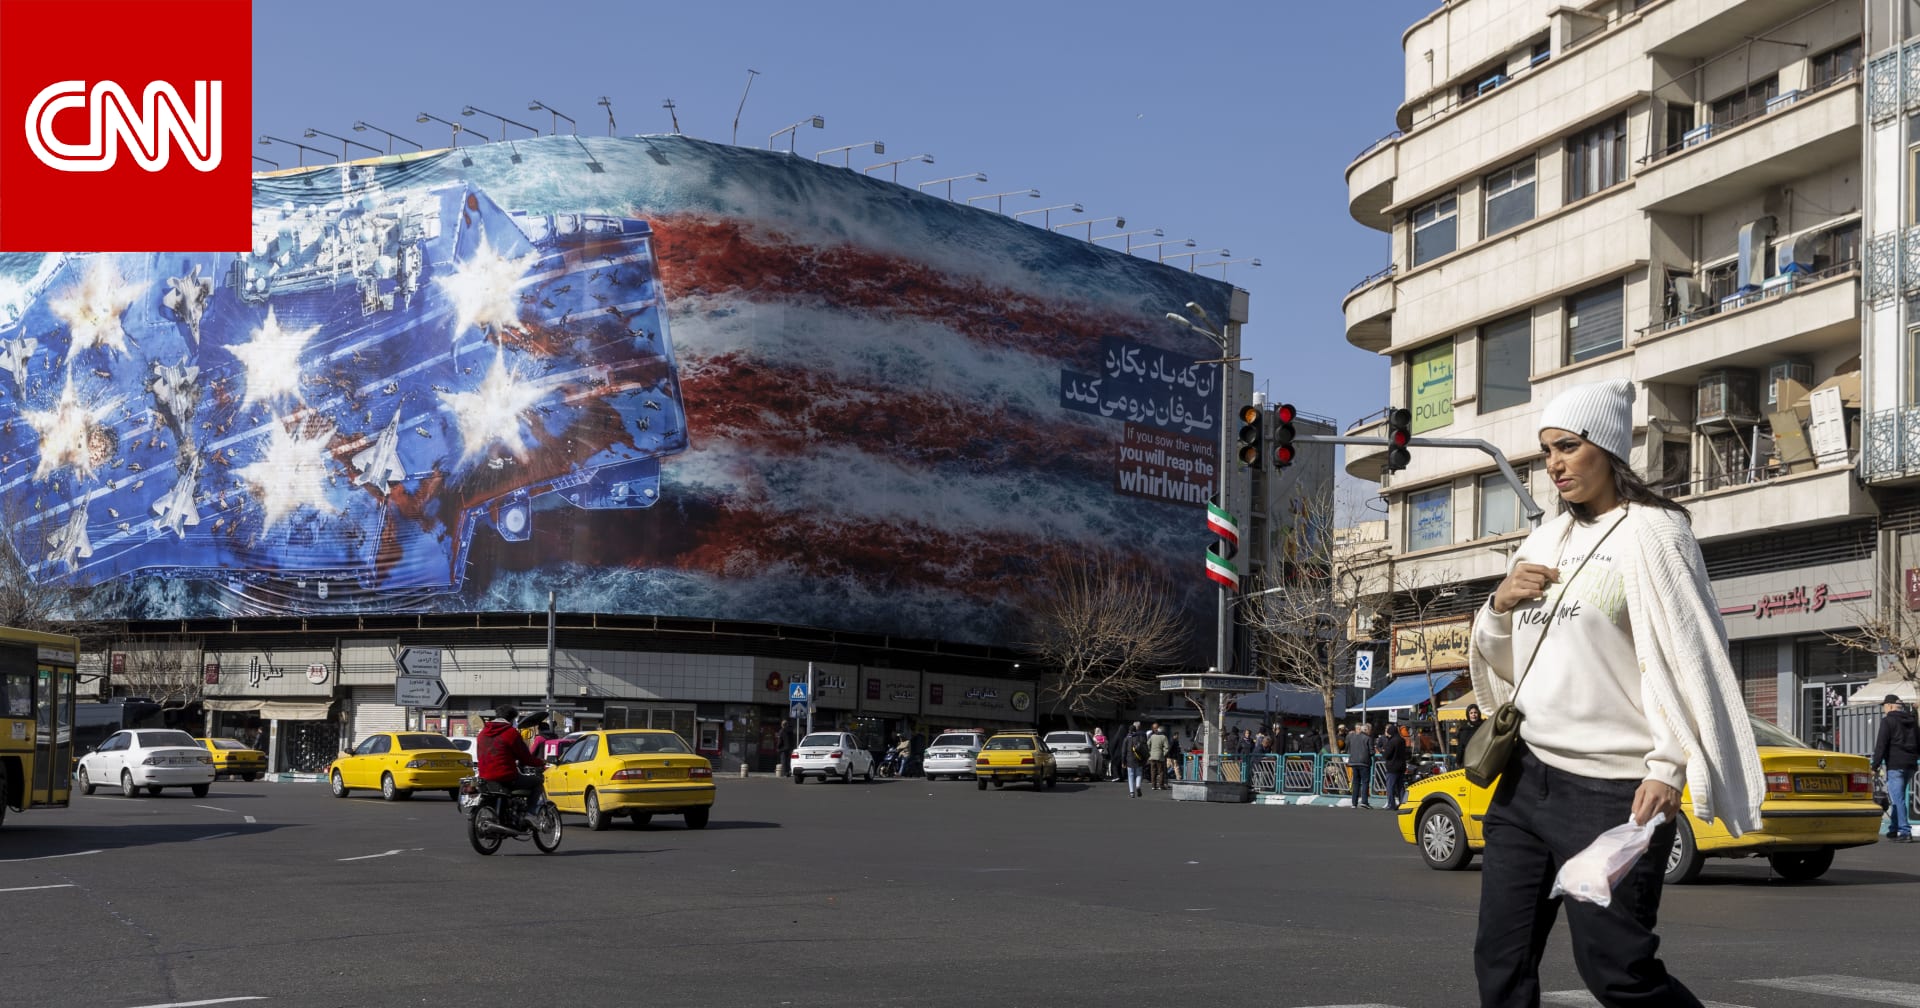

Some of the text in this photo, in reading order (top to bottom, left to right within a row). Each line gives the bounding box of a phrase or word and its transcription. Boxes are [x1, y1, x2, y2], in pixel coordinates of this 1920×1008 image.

[1105, 345, 1146, 383] بکارد
[1149, 354, 1176, 391] باد
[1417, 364, 1453, 395] لیس
[1155, 395, 1213, 434] طوفان
[1120, 445, 1214, 477] you will reap the
[1127, 427, 1214, 458] If you sow the wind,
[1119, 467, 1213, 504] whirlwind
